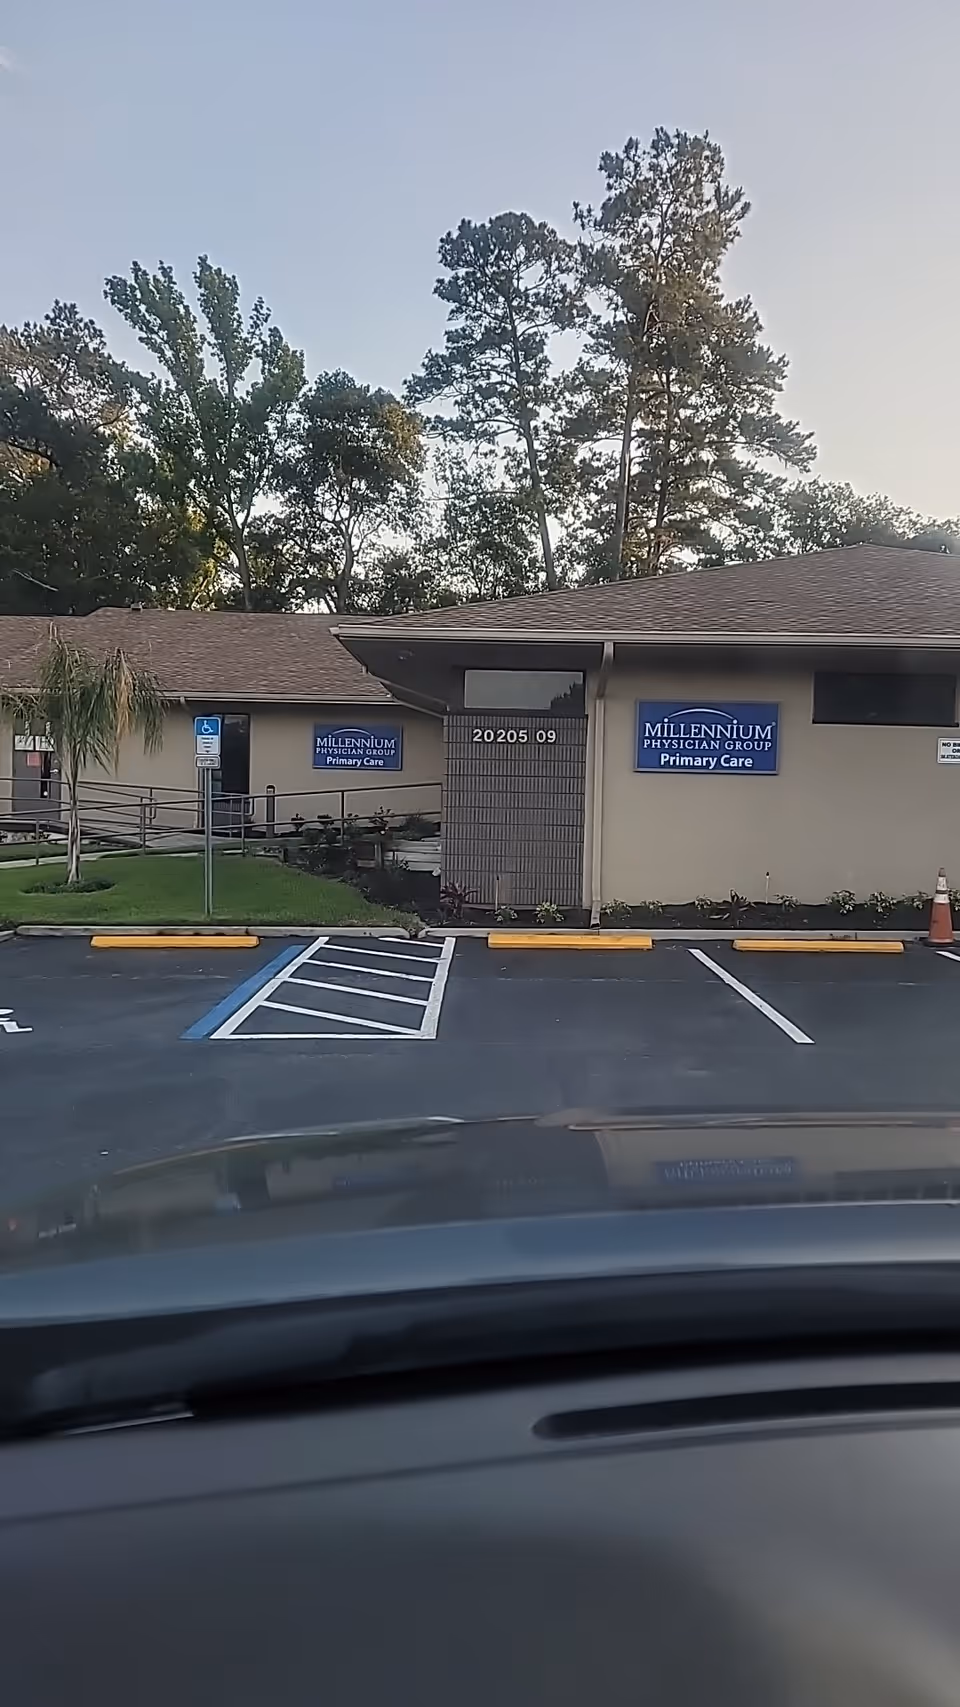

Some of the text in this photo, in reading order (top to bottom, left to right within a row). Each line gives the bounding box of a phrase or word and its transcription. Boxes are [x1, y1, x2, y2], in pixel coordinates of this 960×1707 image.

[644, 719, 772, 740] MILLENNIUM
[316, 735, 395, 748] MILLENNIUM
[536, 730, 556, 743] 09
[316, 747, 363, 755] PHYSICIAN
[643, 739, 772, 750] PHYSICIAN GROUP
[326, 756, 384, 767] Primary Care
[660, 753, 753, 769] Primary Care
